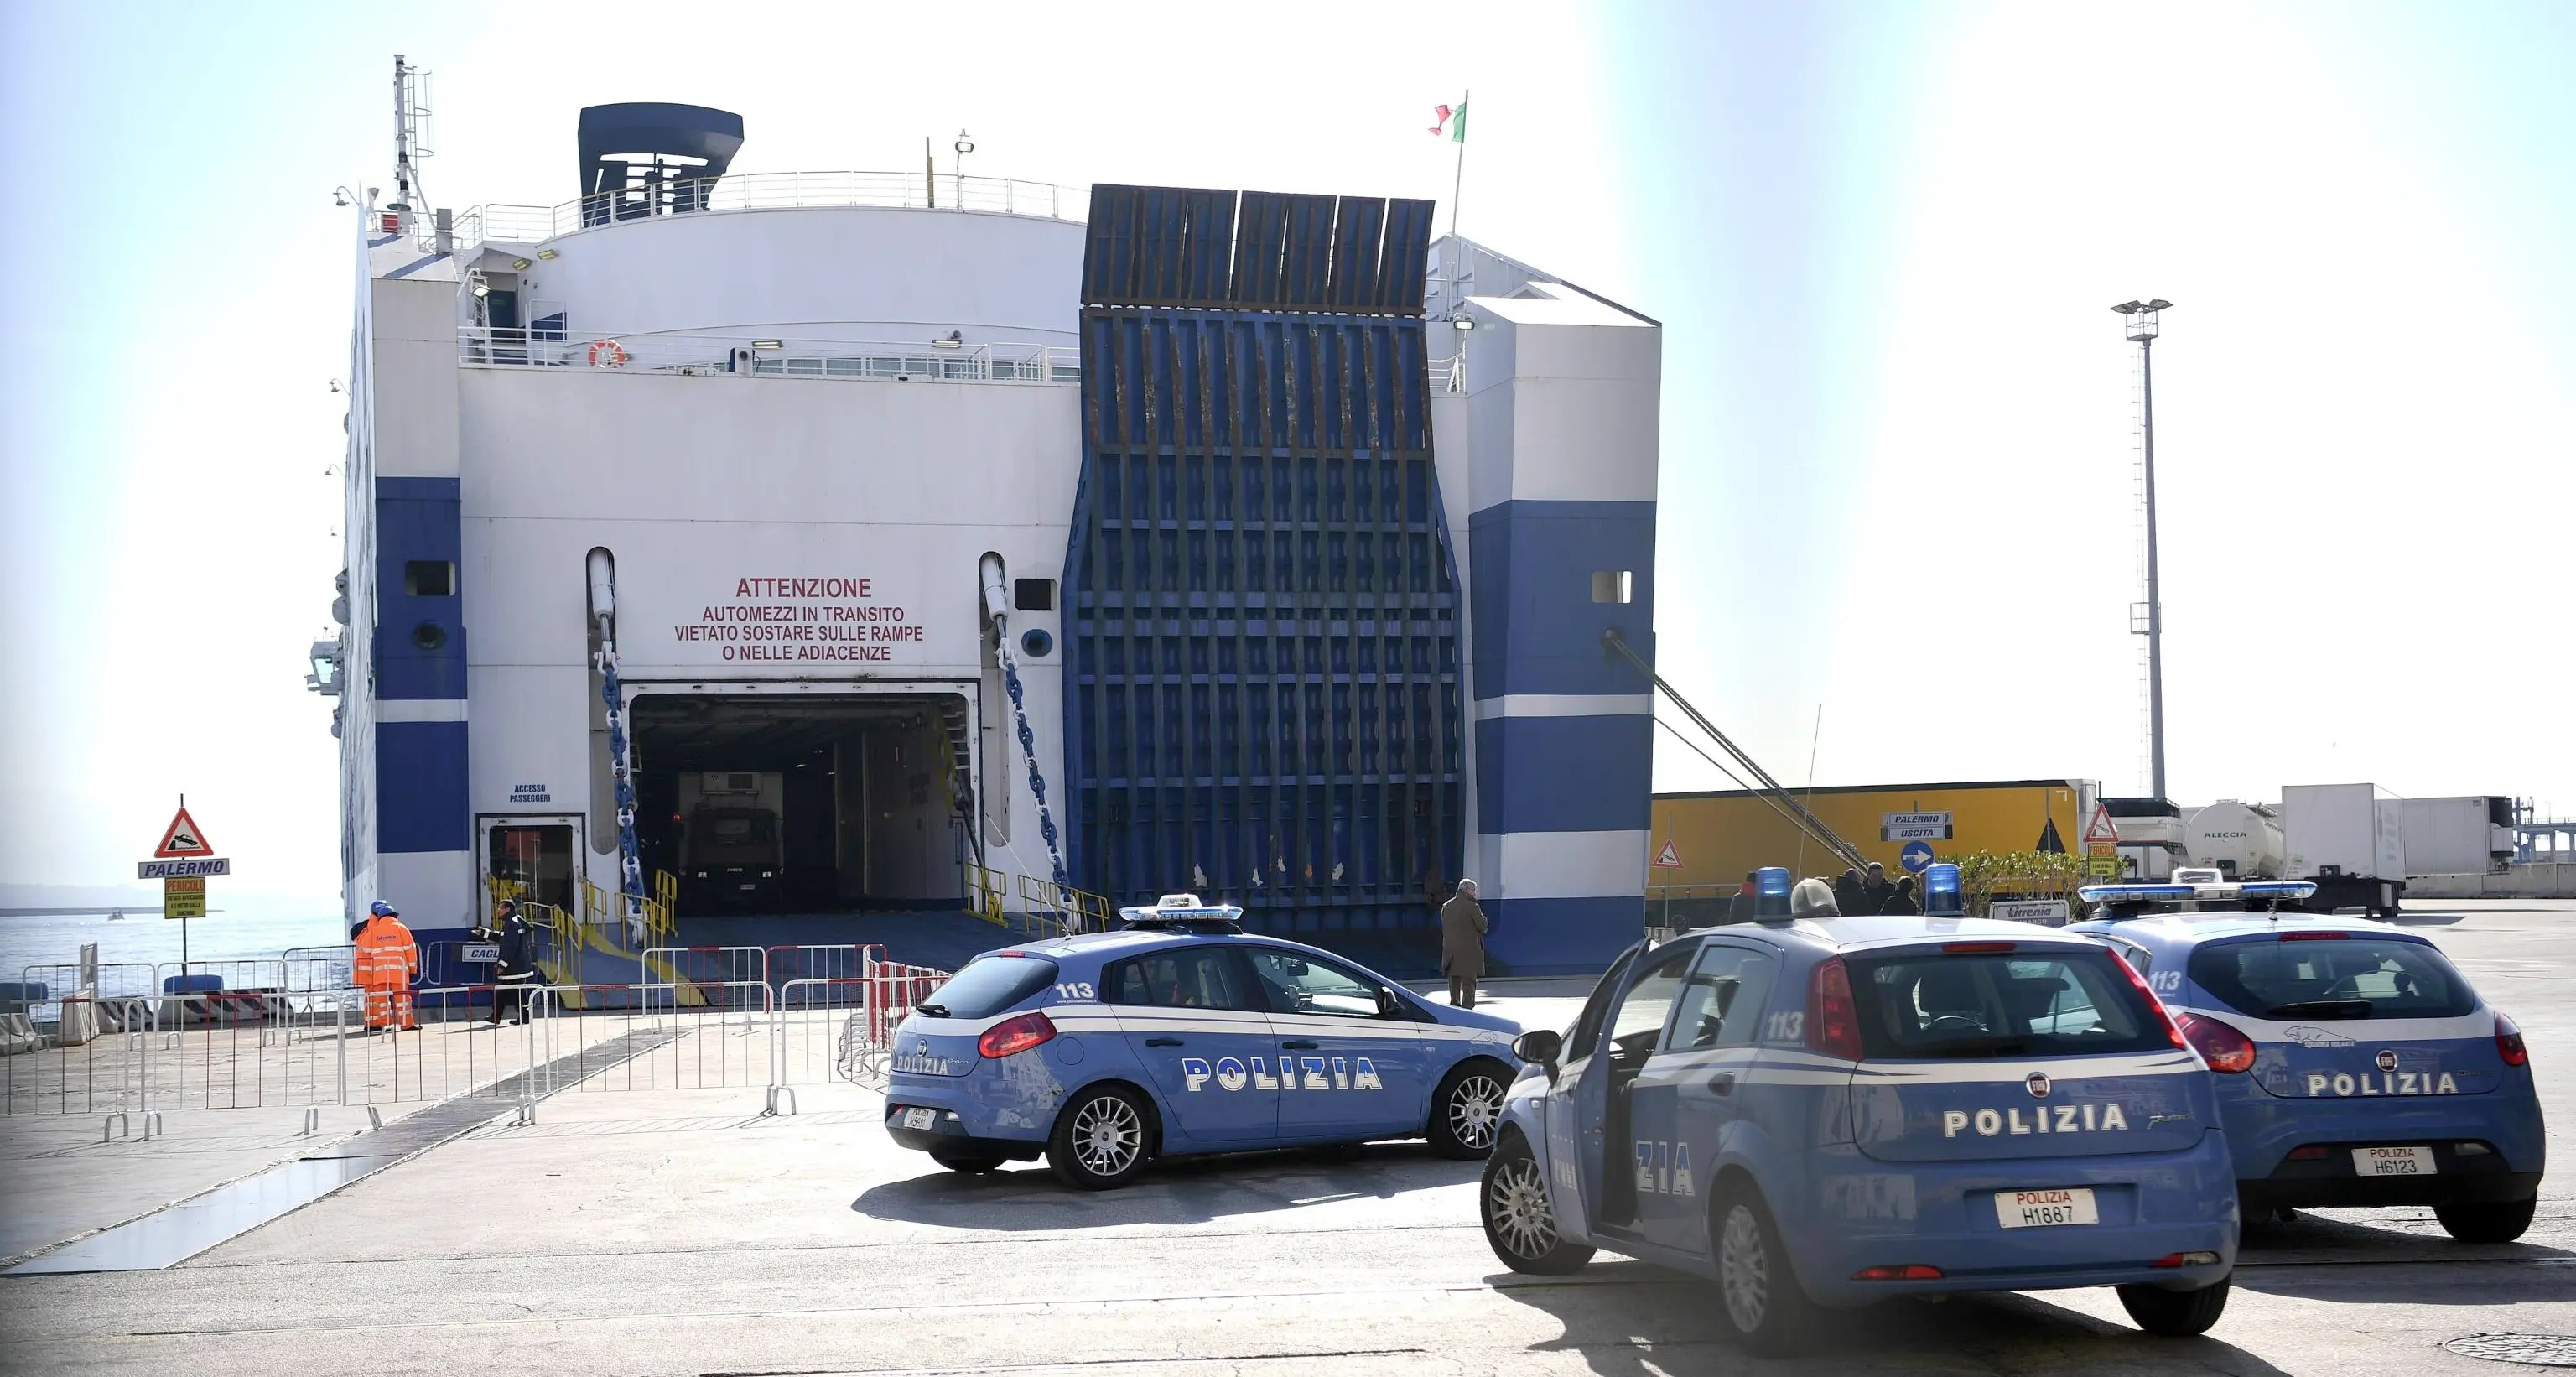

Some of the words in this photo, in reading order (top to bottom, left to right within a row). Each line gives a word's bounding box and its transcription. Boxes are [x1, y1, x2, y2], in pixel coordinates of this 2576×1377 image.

[735, 578, 871, 598] ATTENZIONE
[702, 606, 797, 621] AUTOMEZZI
[802, 606, 818, 621] IN
[823, 606, 905, 622] TRANSITO
[674, 626, 738, 642] VIETATO
[743, 626, 814, 642] SOSTARE
[818, 626, 867, 642] SULLE
[870, 626, 923, 642] RAMPE
[722, 646, 735, 661] O
[740, 646, 794, 661] NELLE
[797, 646, 891, 661] ADIACENZE
[514, 784, 546, 792] ACCESSO
[510, 794, 551, 803] PASSEGGERI
[1901, 829, 1934, 838] USCITA
[144, 860, 225, 876] PALERMO
[471, 949, 499, 958] CAGL
[2149, 970, 2181, 990] 113
[1055, 982, 1095, 998] 113
[1768, 1010, 1805, 1040] 113
[897, 1057, 948, 1076] POLIZIA
[1181, 1057, 1384, 1092] POLIZIA
[2308, 1072, 2459, 1097] POLIZIA
[1944, 1104, 2128, 1138] POLIZIA
[2370, 1149, 2415, 1158] POLIZIA
[2375, 1159, 2417, 1174] H6123
[2017, 1192, 2073, 1204] POLIZIA
[2023, 1206, 2073, 1224] H1887
